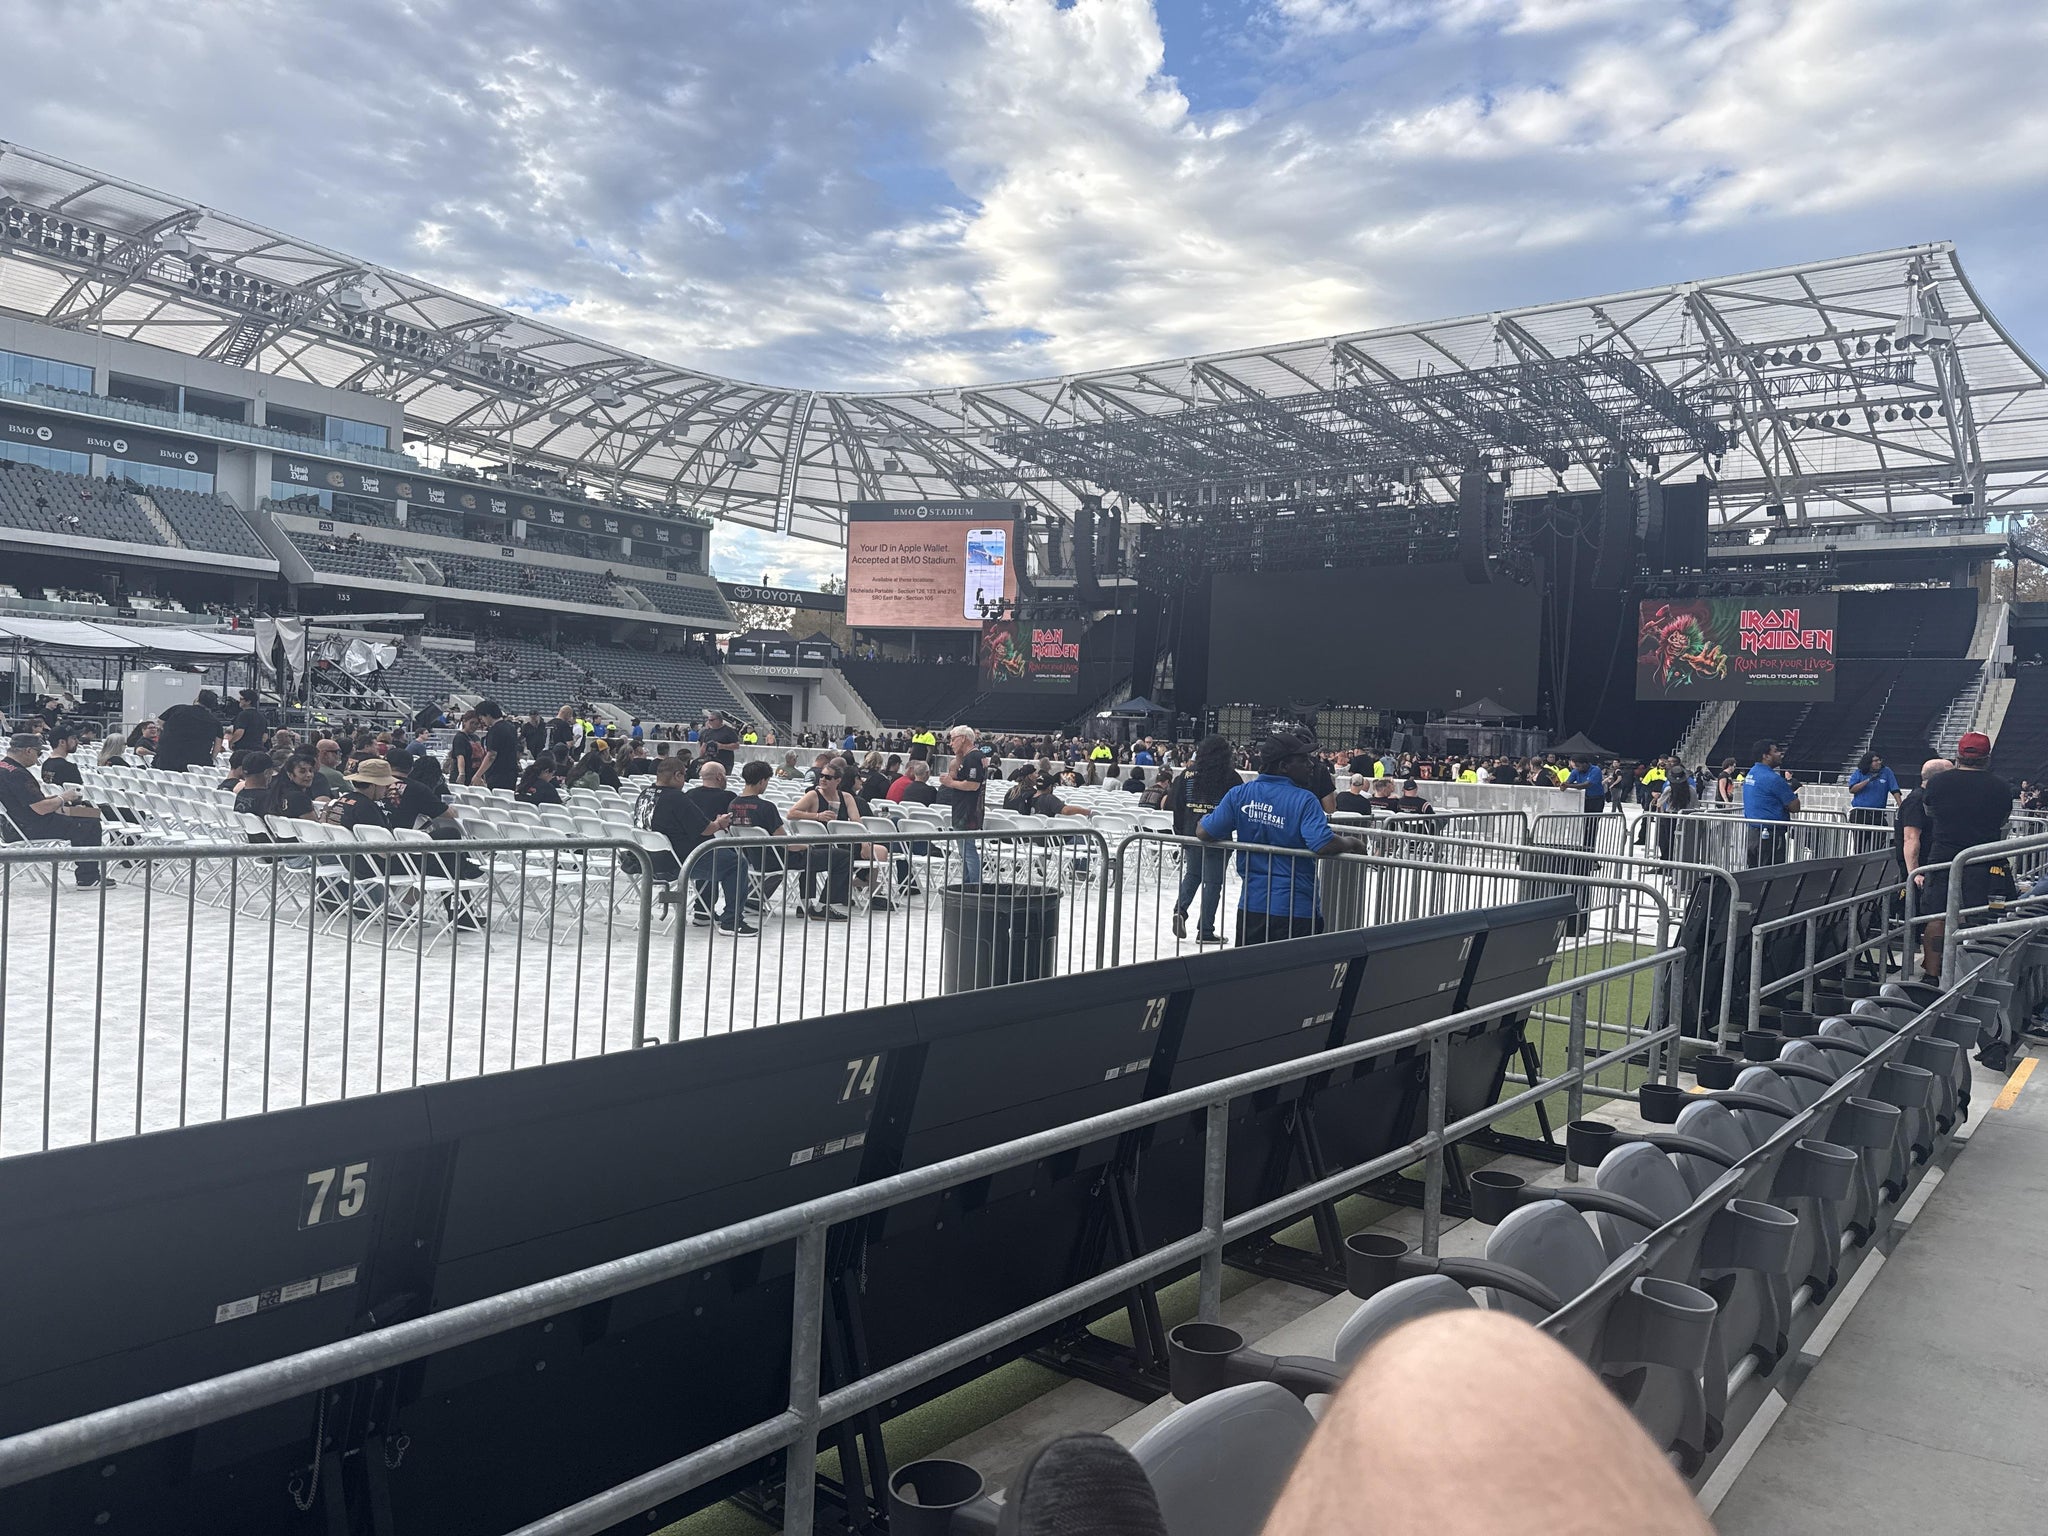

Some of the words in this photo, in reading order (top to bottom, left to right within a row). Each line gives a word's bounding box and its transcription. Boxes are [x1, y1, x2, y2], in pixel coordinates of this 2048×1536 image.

[8, 424, 34, 436] BMO
[87, 437, 111, 448] BMO
[160, 449, 183, 460] BMO
[290, 471, 309, 481] Death
[362, 484, 379, 493] Death
[893, 508, 915, 516] BMO
[929, 508, 974, 516] STADIUM
[320, 523, 333, 531] 233
[860, 544, 878, 552] Your
[879, 544, 888, 552] ID
[890, 544, 897, 552] in
[898, 544, 921, 554] Apple
[923, 544, 950, 552] Wallet.
[852, 556, 889, 565] Accepted
[891, 556, 899, 564] at
[901, 556, 920, 564] BMO
[922, 556, 957, 564] Stadium.
[754, 589, 803, 604] TOYOTA
[1740, 609, 1800, 634] IRON
[1032, 629, 1063, 647] IRON
[1739, 629, 1833, 656] MAIDEN
[1032, 644, 1079, 662] MAIDEN
[764, 666, 799, 675] TOYOTA
[1734, 656, 1758, 672] RUN
[1760, 659, 1777, 668] FOR
[1780, 659, 1802, 670] YOUR
[1249, 800, 1273, 813] ALLIED
[1248, 809, 1285, 825] UNIVERSAL
[1330, 962, 1348, 989] 72
[1141, 997, 1166, 1030] 73
[842, 1055, 880, 1100] 74
[307, 1162, 369, 1226] 75
